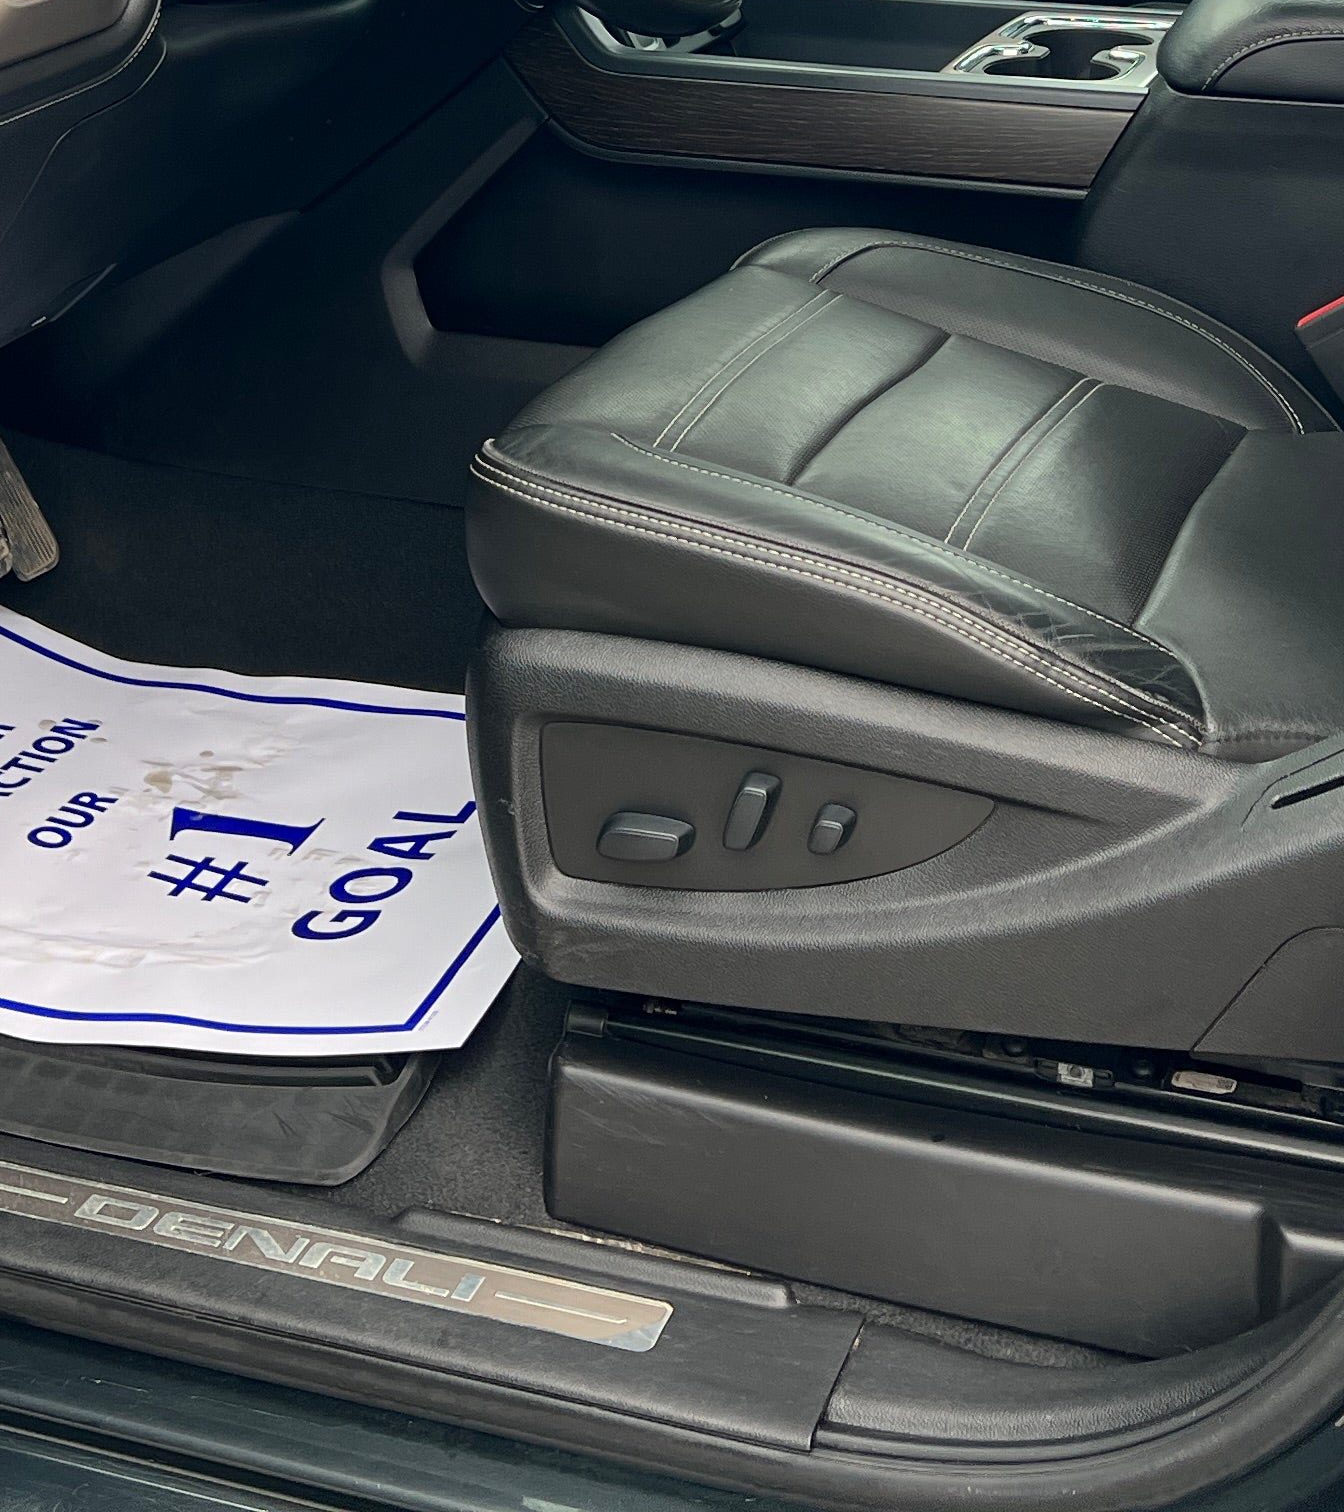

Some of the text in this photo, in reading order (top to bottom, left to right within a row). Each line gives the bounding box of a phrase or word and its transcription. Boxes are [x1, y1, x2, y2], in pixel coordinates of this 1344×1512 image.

[26, 790, 118, 850] OUR
[148, 806, 327, 904] #1
[292, 800, 477, 941] GOAL
[73, 1193, 486, 1303] DENALI
